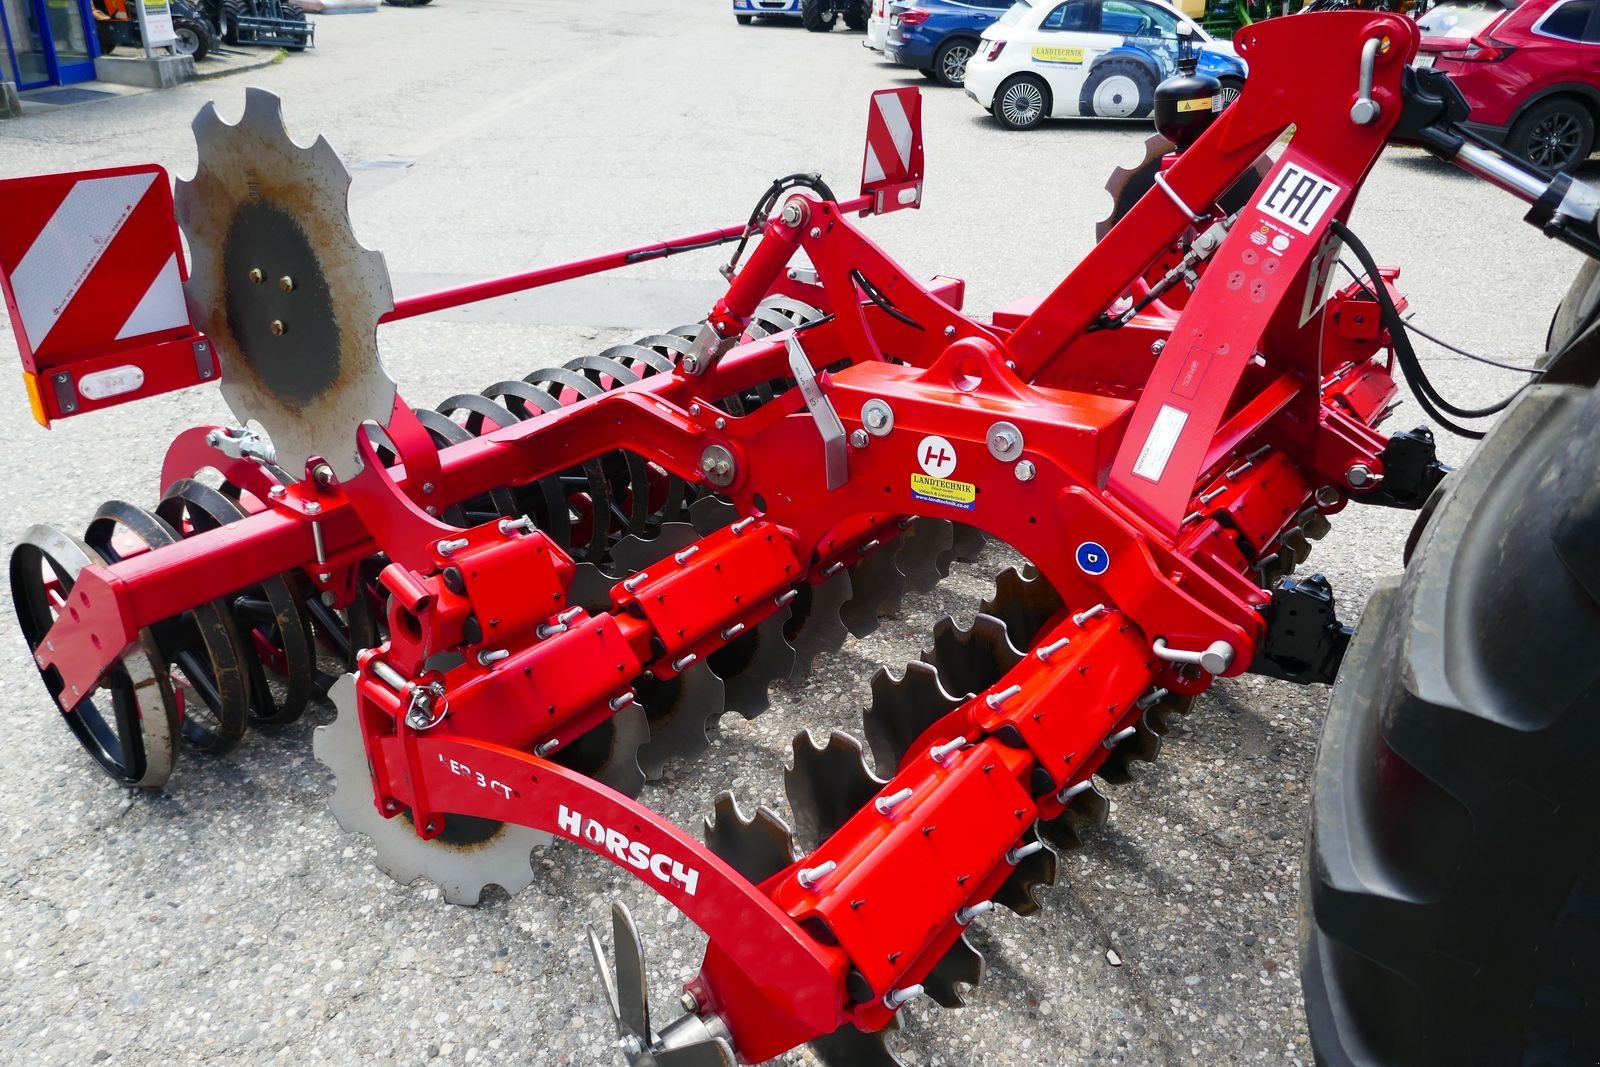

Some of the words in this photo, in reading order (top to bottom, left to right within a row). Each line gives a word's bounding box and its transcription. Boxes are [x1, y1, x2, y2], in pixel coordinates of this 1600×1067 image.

[1036, 47, 1082, 57] LANDTECHNIK
[1264, 167, 1333, 227] EAC
[914, 475, 971, 493] LANDTECHNIK
[475, 771, 487, 788] 3
[557, 804, 700, 896] HORSCH
